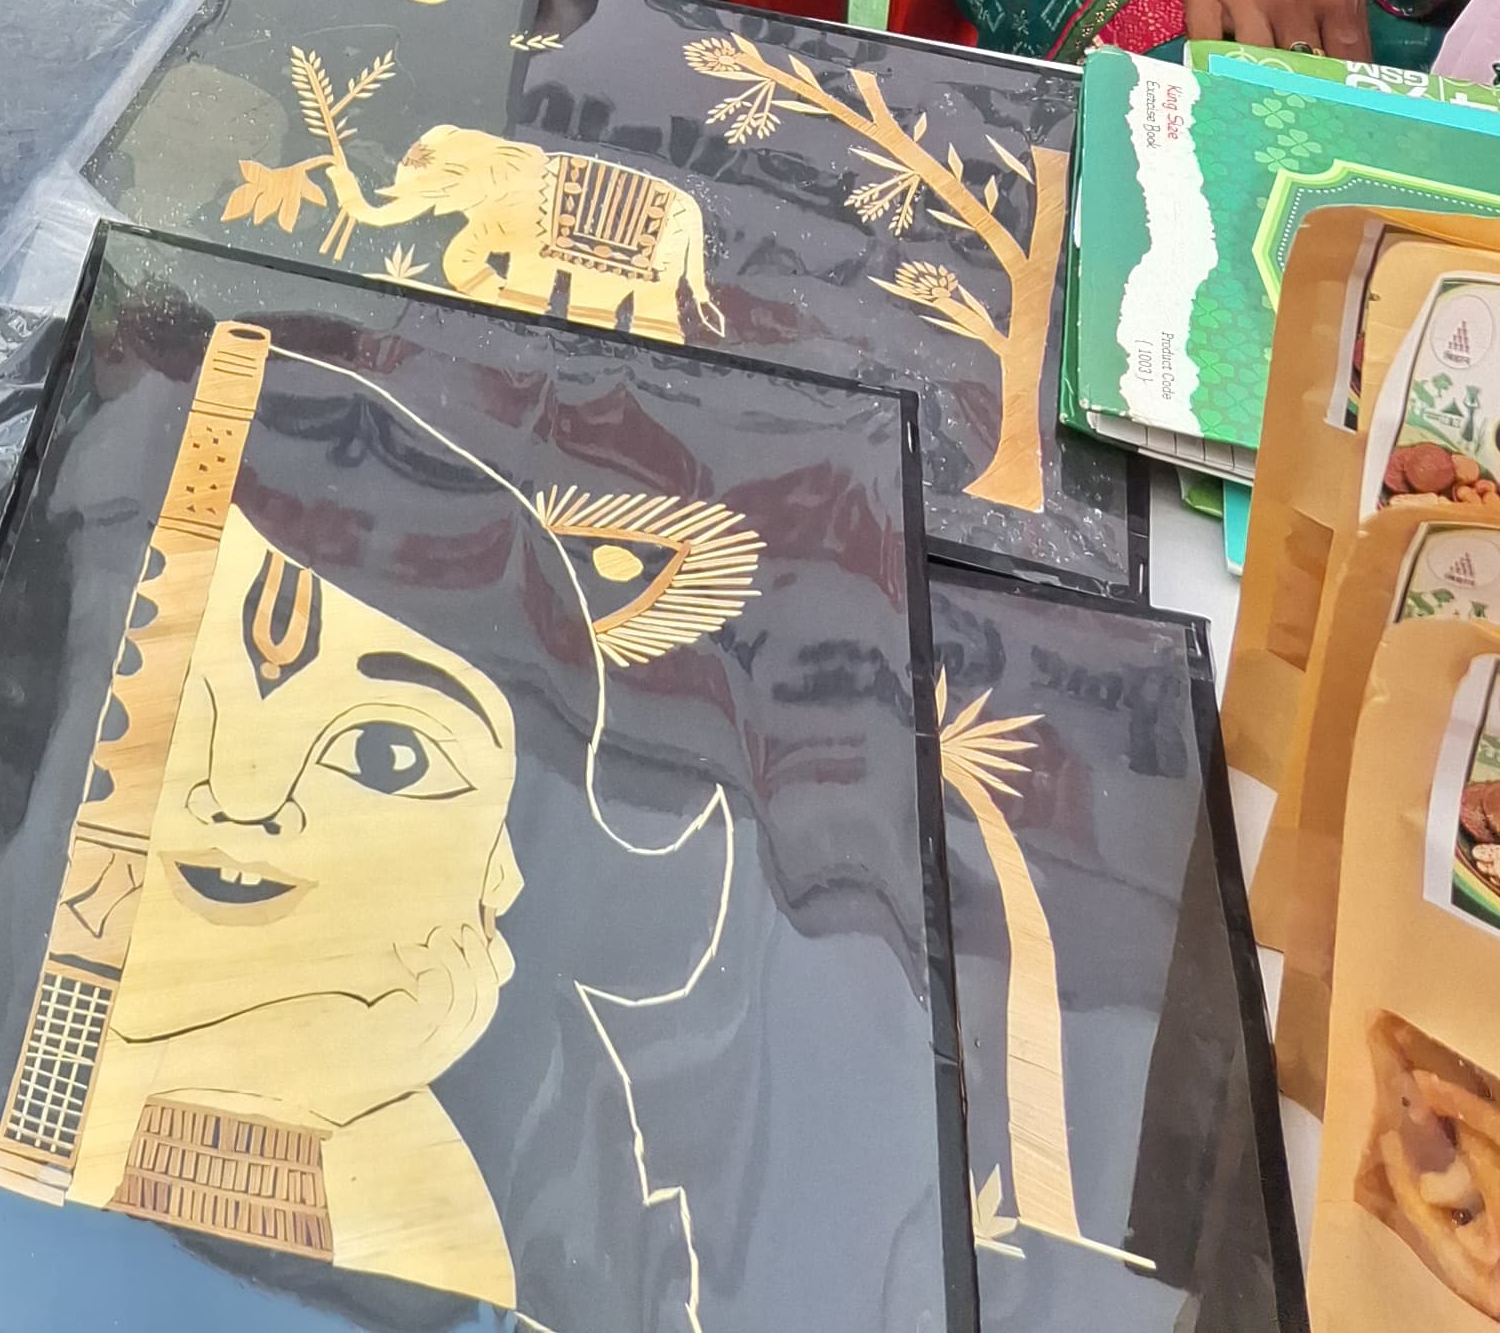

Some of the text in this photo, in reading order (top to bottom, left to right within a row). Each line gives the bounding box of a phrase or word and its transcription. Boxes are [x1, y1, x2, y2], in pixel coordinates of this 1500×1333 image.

[1143, 123, 1162, 149] Book
[1162, 84, 1185, 140] King Size
[1161, 331, 1176, 400] Product Code
